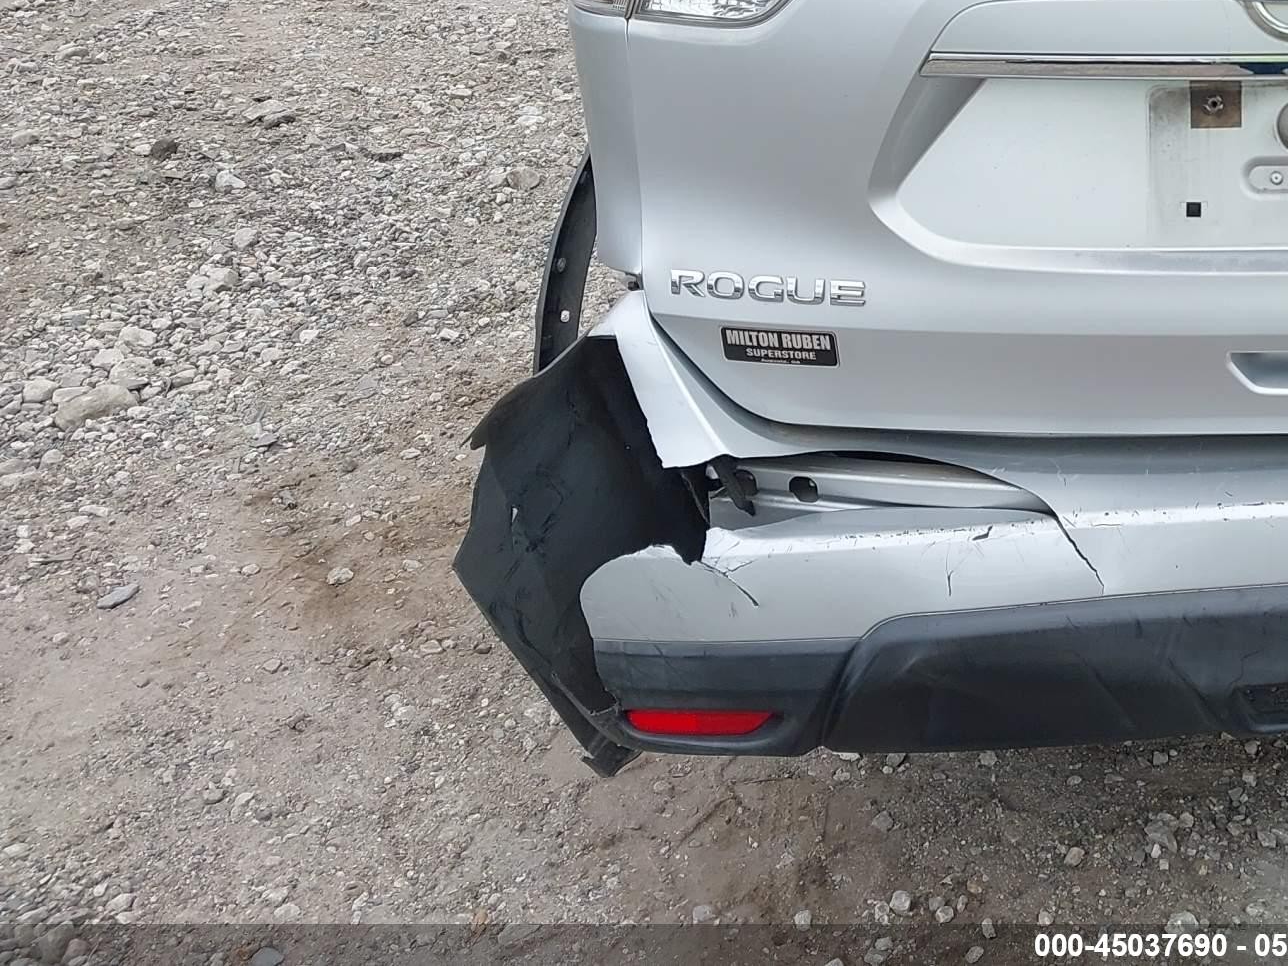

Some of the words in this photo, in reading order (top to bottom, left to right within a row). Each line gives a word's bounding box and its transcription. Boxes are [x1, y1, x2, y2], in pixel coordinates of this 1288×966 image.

[670, 268, 866, 307] ROGUE
[725, 329, 780, 348] MILTON
[781, 333, 832, 351] RUBEN
[745, 347, 817, 360] SUPERSTORE
